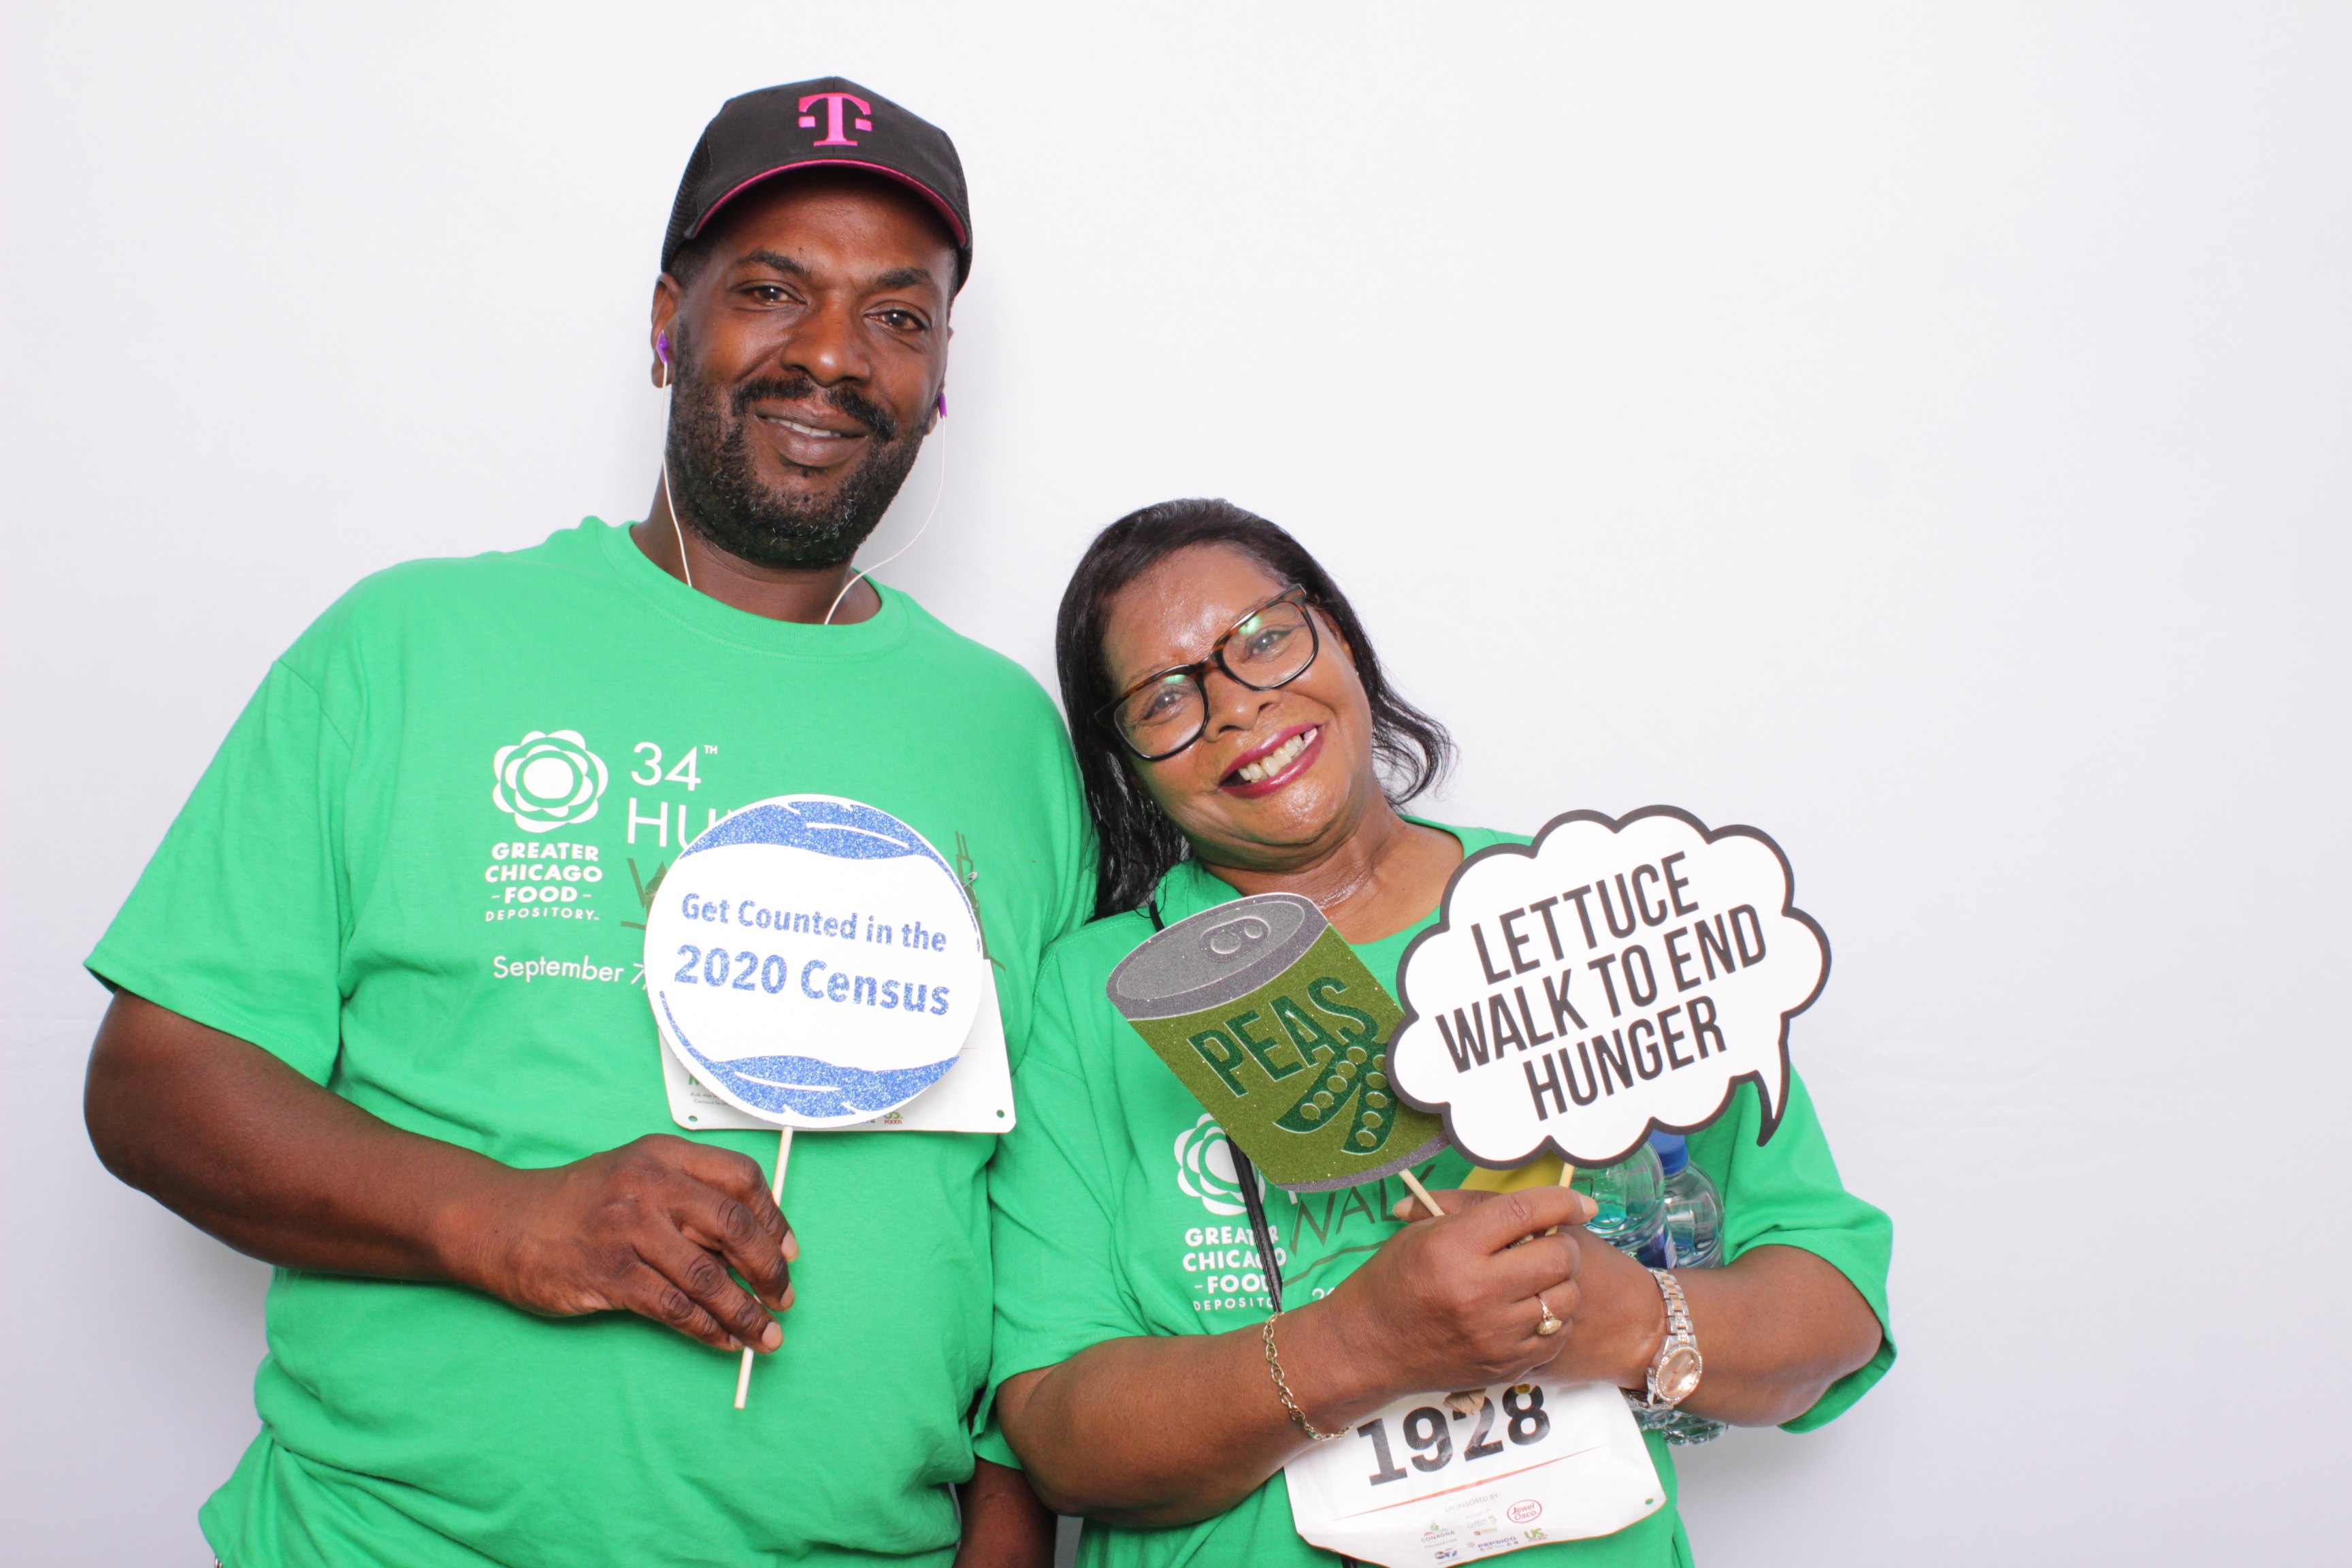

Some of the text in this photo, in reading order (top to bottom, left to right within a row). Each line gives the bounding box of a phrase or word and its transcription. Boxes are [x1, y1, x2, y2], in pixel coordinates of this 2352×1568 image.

[627, 797, 733, 850] HU
[491, 842, 599, 862] GREATER
[485, 864, 603, 883] CHICAGO
[485, 907, 595, 921] DEPOSITORY
[682, 893, 947, 952] Get Counted in the
[1471, 851, 1699, 985] LETTUCE
[493, 956, 624, 983] September
[674, 944, 950, 1015] 2020 Census
[1435, 903, 1767, 1074] WALK TO END
[1186, 977, 1379, 1098] PEAS
[1523, 996, 1727, 1122] HUNGER
[1185, 1225, 1279, 1247] GREATR
[1356, 1384, 1550, 1486] 1928
[1445, 1495, 1488, 1513] SPONSORED
[1512, 1502, 1535, 1514] Jewel
[1421, 1531, 1455, 1542] CONAGRA
[1477, 1536, 1516, 1548] PEPSICO
